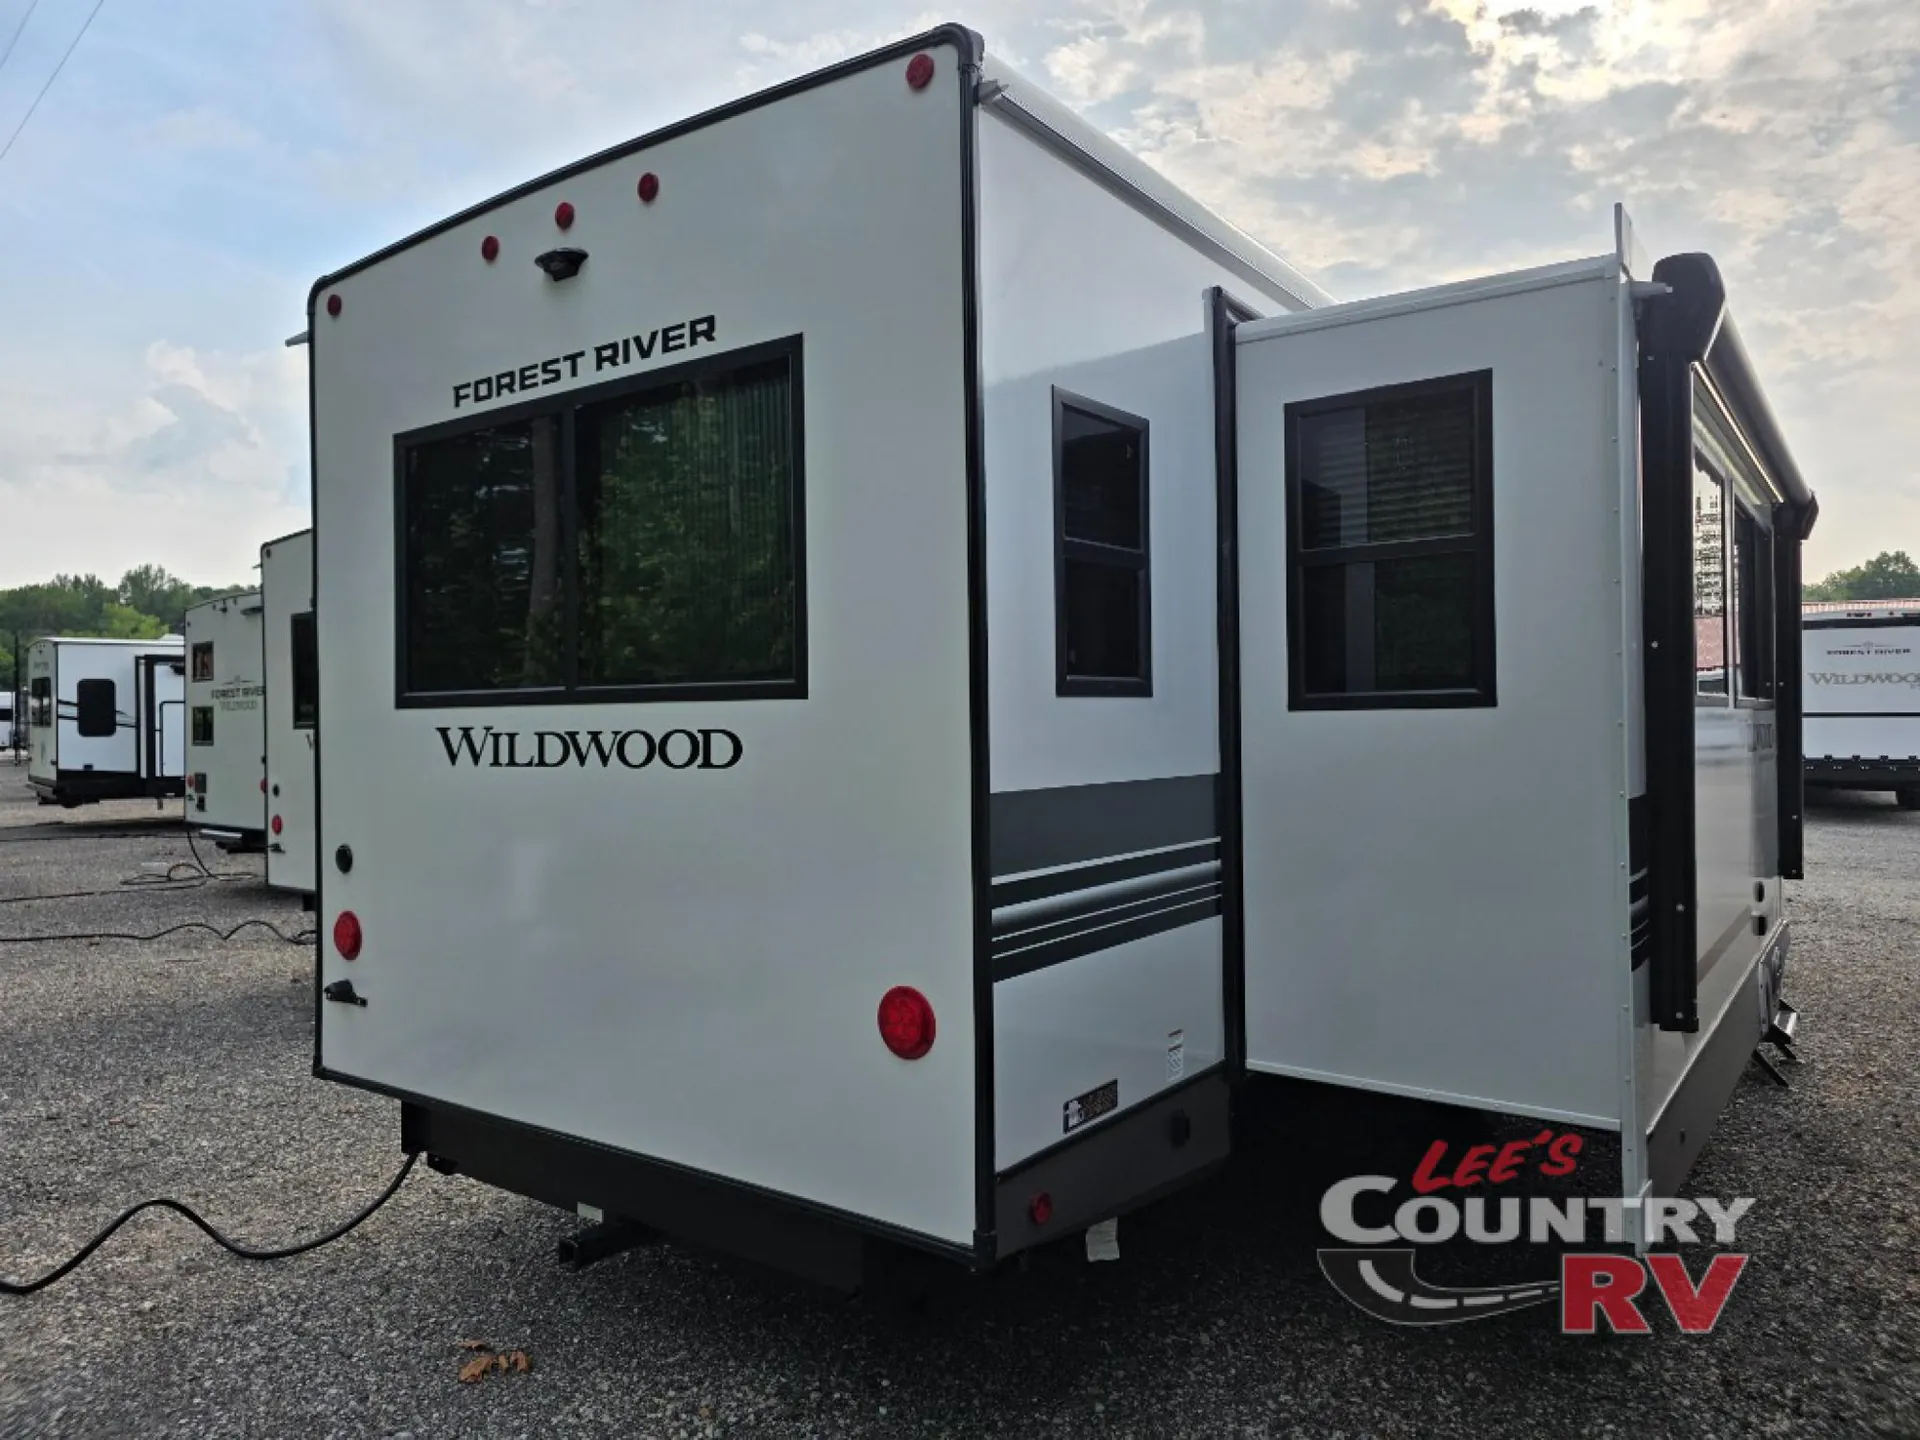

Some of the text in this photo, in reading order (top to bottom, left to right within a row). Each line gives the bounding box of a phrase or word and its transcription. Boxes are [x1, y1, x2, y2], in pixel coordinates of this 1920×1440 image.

[452, 314, 717, 409] FOREST RIVER
[436, 726, 743, 770] WILDWOOD
